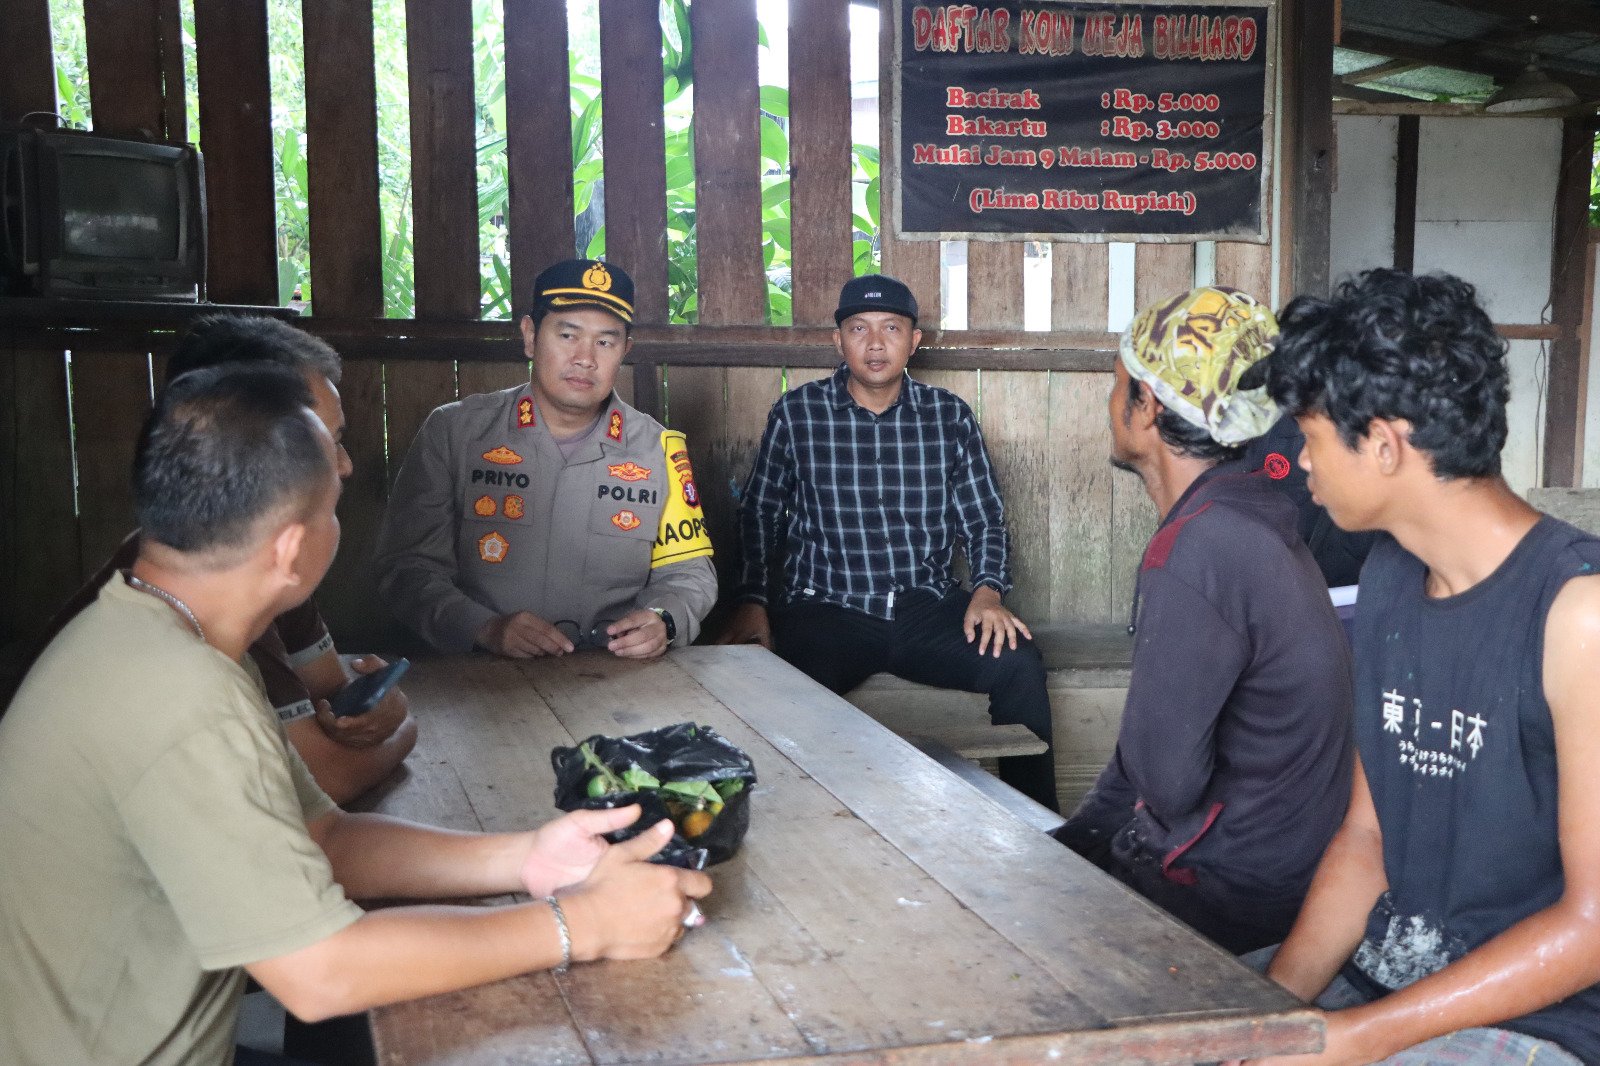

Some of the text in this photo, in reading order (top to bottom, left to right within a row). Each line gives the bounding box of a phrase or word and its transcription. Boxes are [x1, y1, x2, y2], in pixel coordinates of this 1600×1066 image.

[913, 6, 1257, 61] DAFTAR KOIN MEJA BILLIARD
[946, 87, 1041, 110] Bacirak
[1158, 92, 1220, 112] 5.000
[946, 114, 1047, 138] Bakartu
[1156, 120, 1220, 140] 3.000
[913, 143, 982, 165] Mulai
[984, 144, 1037, 167] Jam
[1039, 148, 1056, 169] 9
[1058, 146, 1137, 168] Malam
[1151, 148, 1191, 172] Rp.
[1193, 152, 1257, 171] 5.000
[969, 188, 1197, 214] (Lima Ribu Rupiah)
[471, 469, 530, 489] PRIYO
[597, 484, 657, 504] POLRI
